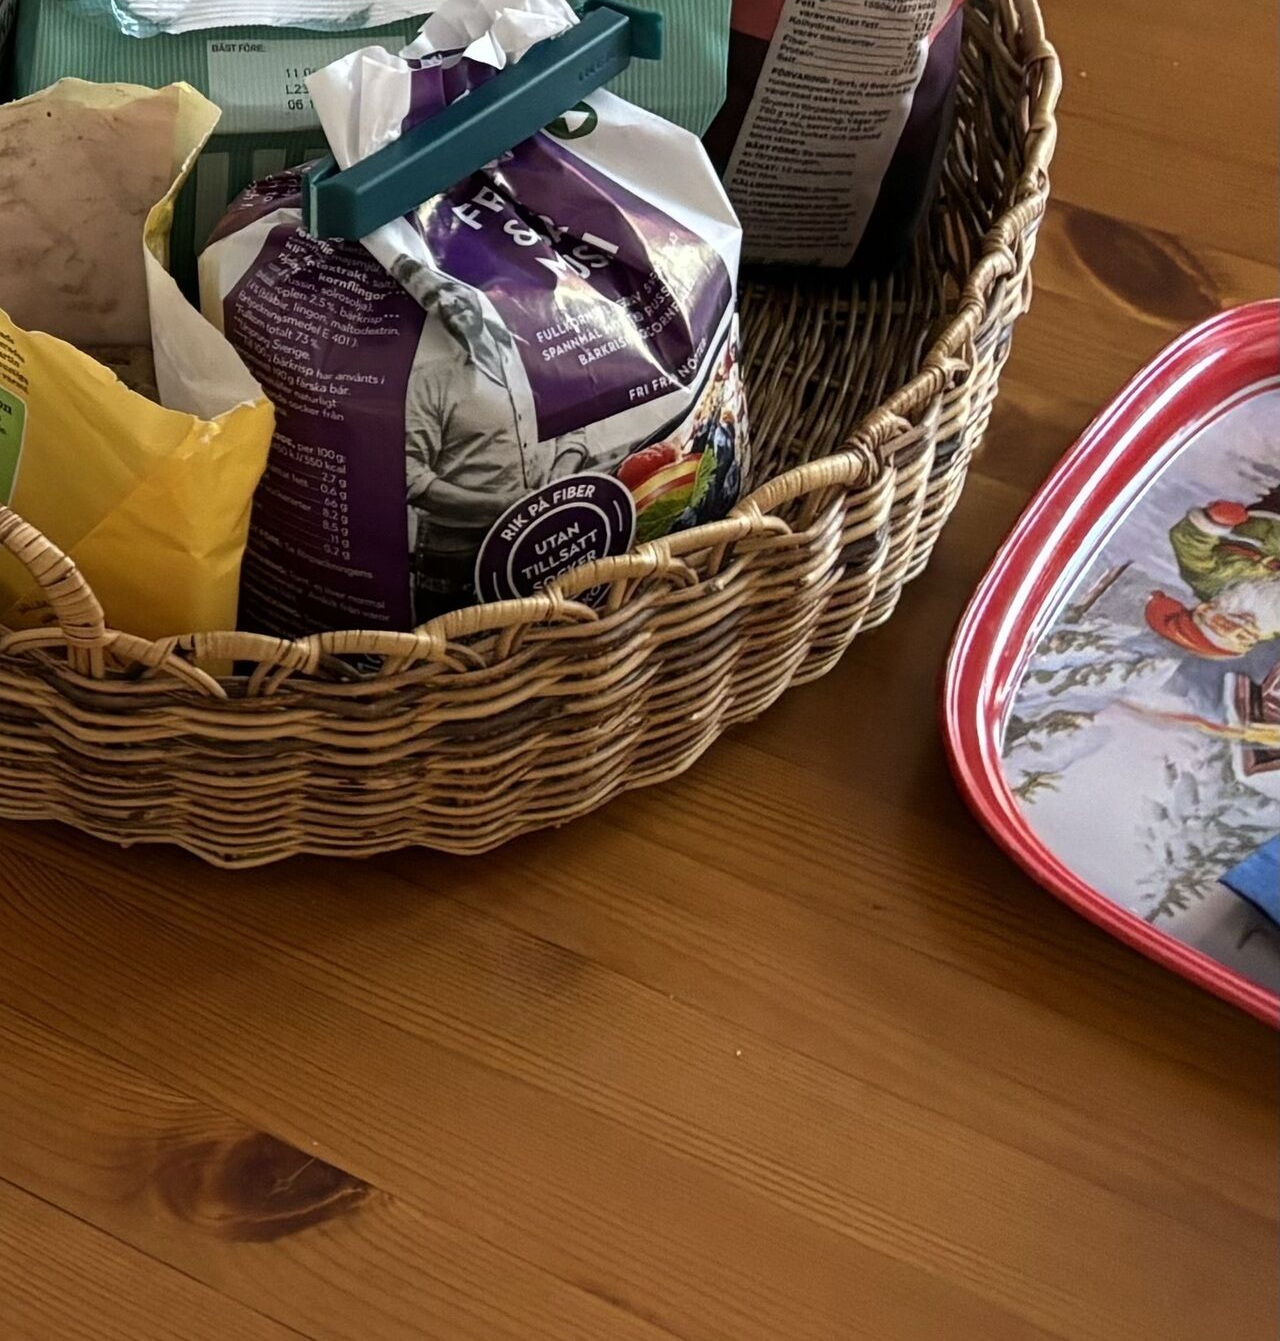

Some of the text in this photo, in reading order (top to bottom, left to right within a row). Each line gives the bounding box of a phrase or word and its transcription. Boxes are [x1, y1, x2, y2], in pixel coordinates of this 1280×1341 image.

[211, 43, 237, 53] BÄST
[287, 99, 304, 111] 06
[318, 271, 388, 302] kornflingor
[628, 383, 650, 402] FRI
[316, 446, 336, 460] 100
[499, 484, 597, 542] RIK PÅ FIBER
[533, 521, 581, 556] UTAN
[520, 528, 599, 581] TILLSATT
